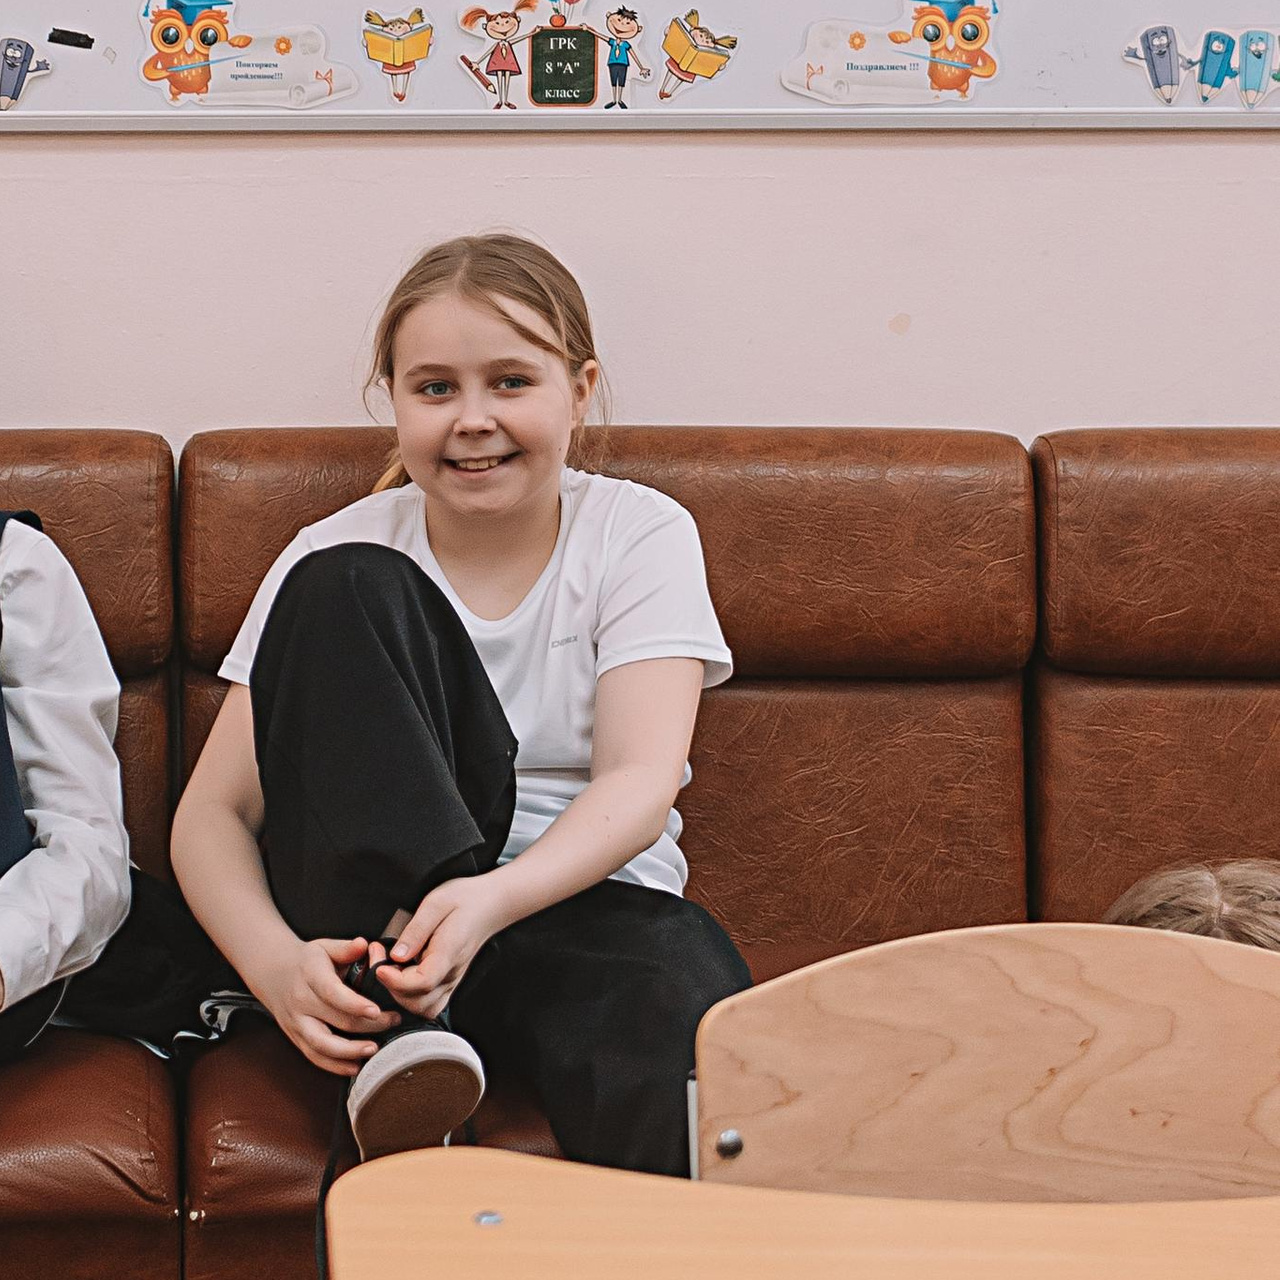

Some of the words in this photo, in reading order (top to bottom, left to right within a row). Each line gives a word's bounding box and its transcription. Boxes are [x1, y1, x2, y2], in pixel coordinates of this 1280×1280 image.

[549, 37, 577, 50] ГРК
[545, 62, 553, 74] 8
[557, 62, 580, 74] "А"
[846, 62, 907, 72] Поздравляем
[909, 62, 919, 70] !!!
[545, 87, 580, 99] класс
